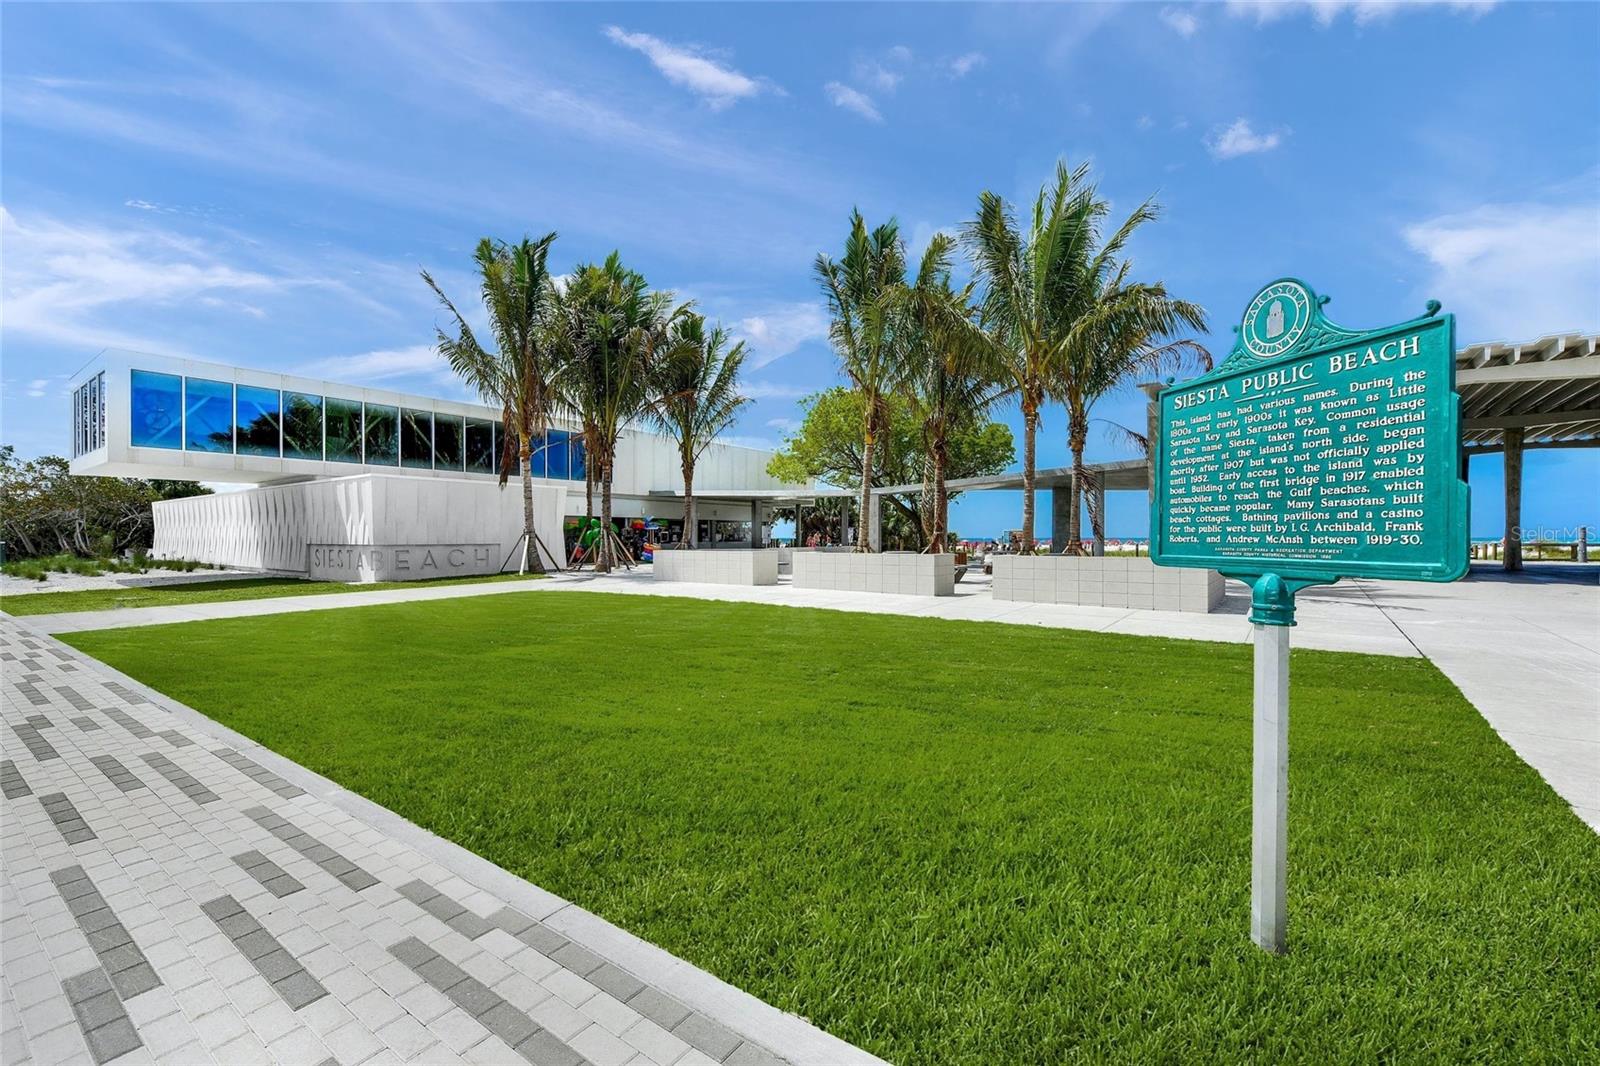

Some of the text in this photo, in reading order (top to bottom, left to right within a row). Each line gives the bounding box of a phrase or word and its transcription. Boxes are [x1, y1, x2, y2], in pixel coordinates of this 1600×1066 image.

[1245, 285, 1306, 325] SARASOTA
[1250, 326, 1301, 354] COUNTY
[1174, 336, 1419, 410] SIESTA PUBLIC BEACH
[1170, 370, 1426, 428] This island has had various names. During the
[1170, 384, 1426, 438] 1800s and early 1900s it was known as Little
[1170, 398, 1425, 447] Sarasota Key and Sarasota Key. Common usage
[1170, 448, 1178, 457] of
[1183, 446, 1196, 455] the
[1201, 443, 1222, 452] name
[1267, 432, 1295, 442] taken
[1303, 427, 1330, 437] from
[1339, 424, 1347, 432] a
[1356, 412, 1425, 430] residential
[1170, 454, 1215, 467] development
[1221, 452, 1229, 460] at
[1237, 449, 1251, 457] the
[1259, 442, 1294, 455] island's
[1302, 438, 1332, 449] north
[1383, 426, 1425, 439] began
[1170, 438, 1425, 476] shortly after 1907 but was not officially applied
[1170, 476, 1186, 485] until
[1219, 471, 1241, 481] Early
[1247, 468, 1278, 478] access
[1284, 466, 1295, 474] to
[1303, 464, 1320, 473] the
[1328, 459, 1363, 470] island
[1373, 456, 1397, 466] was
[1407, 453, 1425, 464] by
[1191, 484, 1223, 493] Building
[1227, 482, 1236, 490] of
[1240, 481, 1255, 490] the
[1259, 478, 1280, 488] first
[1285, 475, 1320, 487] bridge
[1325, 474, 1336, 483] in
[1342, 471, 1366, 482] 1917
[1372, 466, 1425, 479] enabled
[1170, 495, 1212, 505] automobiles
[1218, 494, 1227, 502] to
[1234, 491, 1259, 500] reach
[1266, 490, 1283, 499] the
[1289, 487, 1312, 497] Gulf
[1384, 480, 1424, 491] which
[1170, 493, 1424, 515] quickly became popular. Many Sarasotans built
[1170, 515, 1191, 523] beach
[1196, 515, 1232, 524] cottages.
[1242, 513, 1278, 523] Bathing
[1284, 511, 1330, 522] pavilions
[1337, 509, 1359, 519] and
[1381, 508, 1424, 518] casino
[1170, 525, 1181, 533] for
[1184, 525, 1195, 533] the
[1198, 524, 1222, 534] public
[1250, 524, 1272, 532] built
[1275, 524, 1287, 534] by
[1385, 521, 1424, 532] Frank
[1206, 535, 1220, 543] and
[1226, 535, 1260, 543] Andrew
[1265, 535, 1303, 544] McAnsh
[1310, 535, 1358, 544] between
[314, 549, 490, 571] SIESTA BEACH
